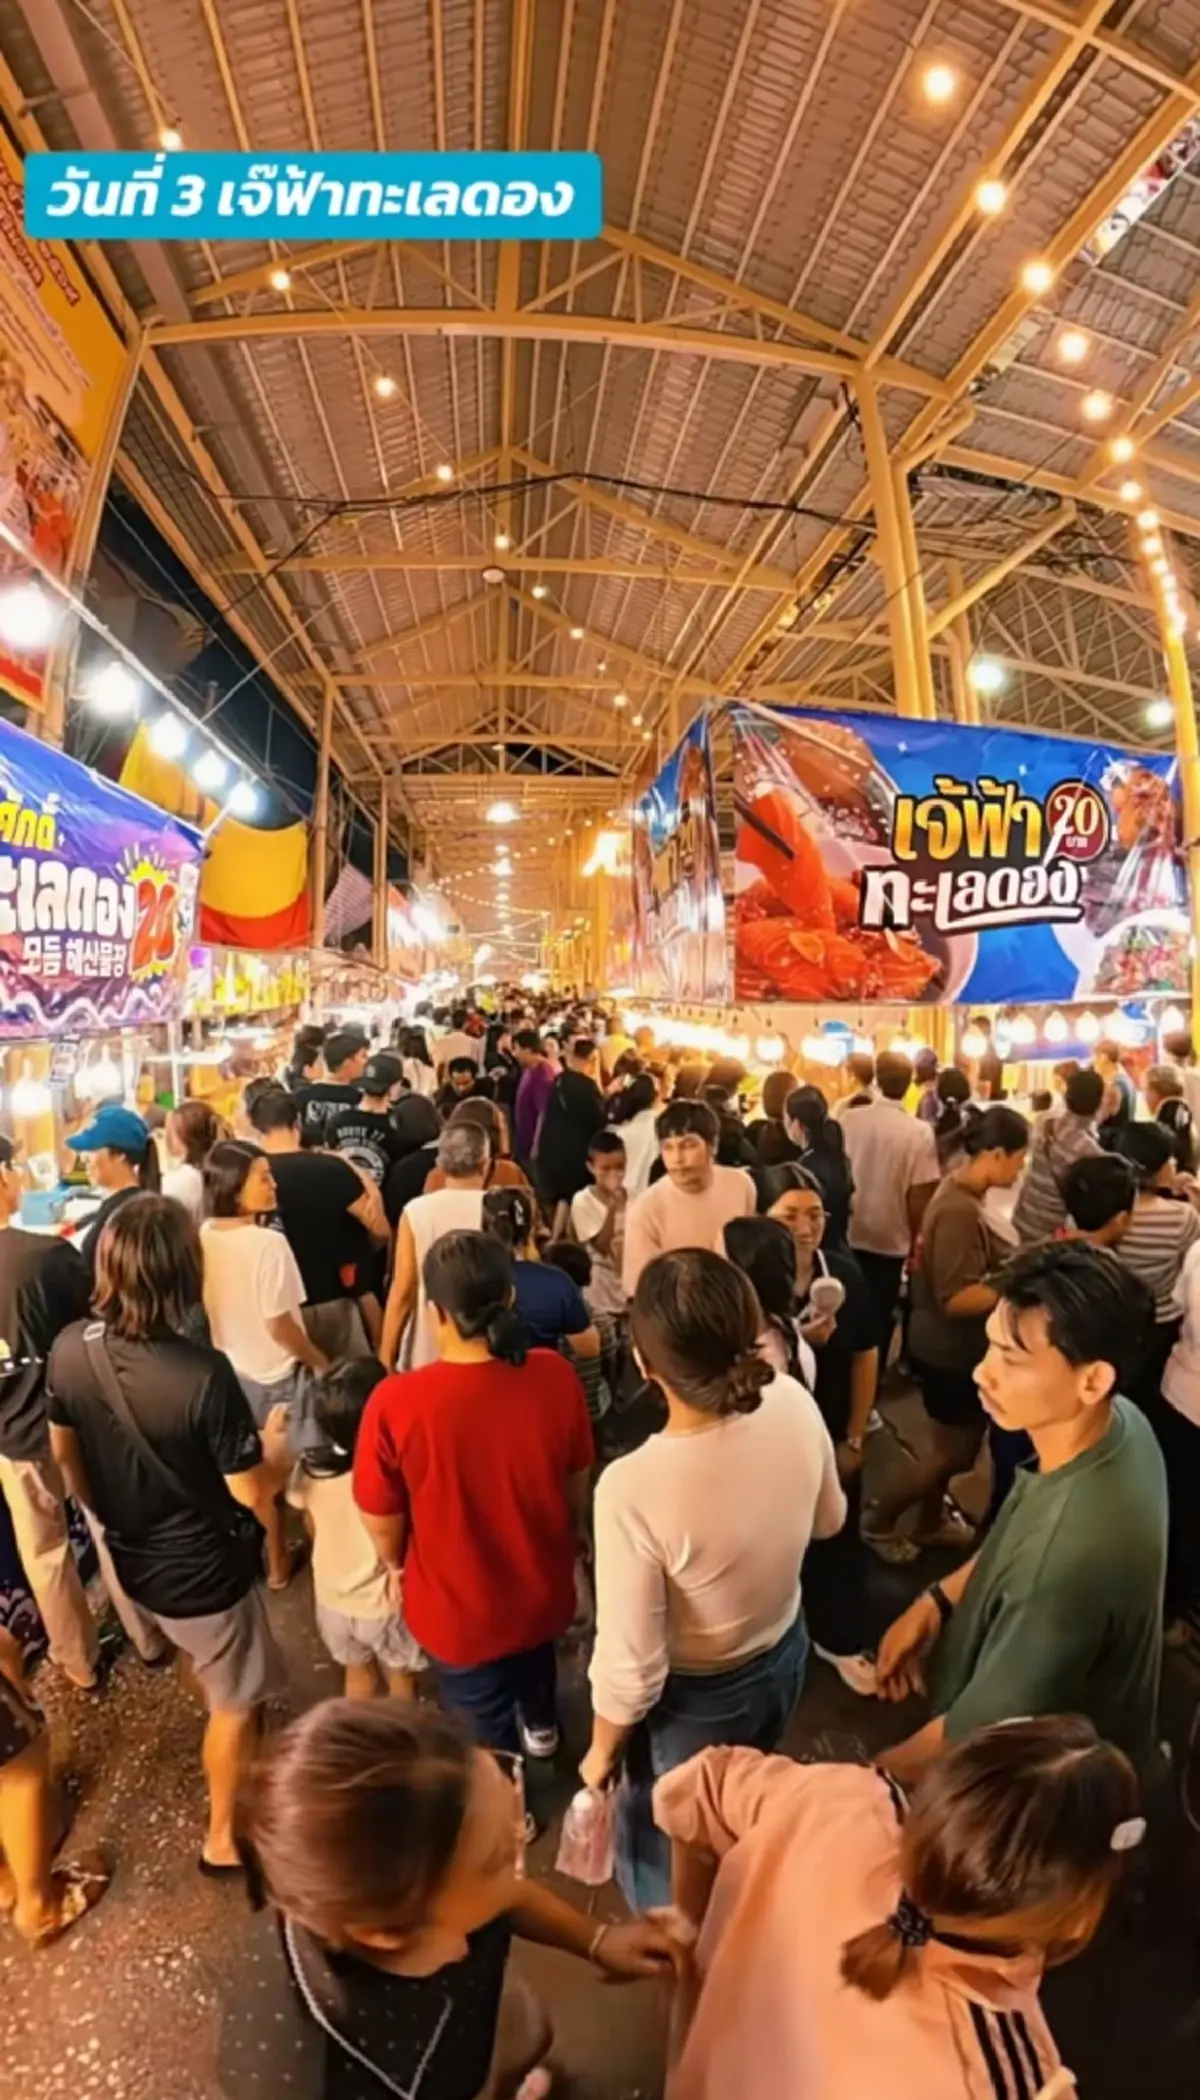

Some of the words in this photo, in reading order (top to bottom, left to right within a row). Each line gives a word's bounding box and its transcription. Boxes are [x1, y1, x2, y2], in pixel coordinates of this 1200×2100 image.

[893, 778, 1043, 861] เจ้ฟ้า
[1052, 796, 1101, 837] 20
[862, 860, 1080, 931] ทะเลดอง
